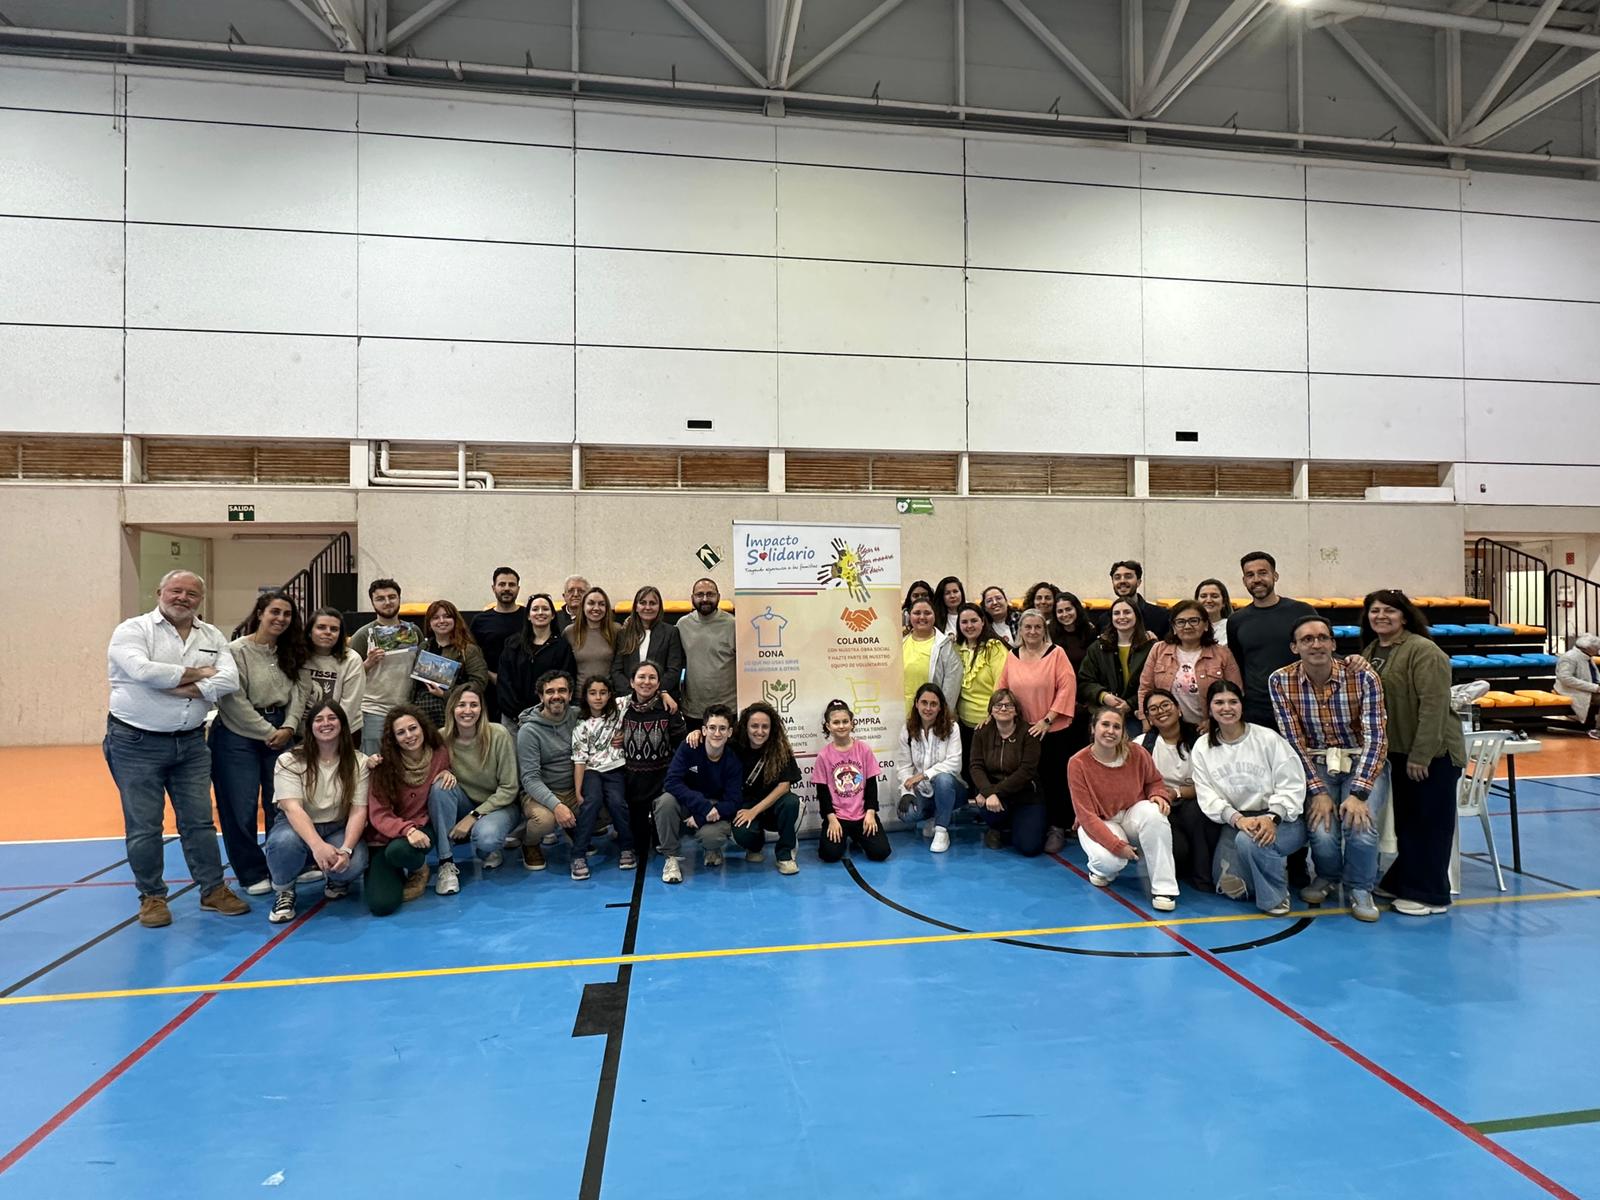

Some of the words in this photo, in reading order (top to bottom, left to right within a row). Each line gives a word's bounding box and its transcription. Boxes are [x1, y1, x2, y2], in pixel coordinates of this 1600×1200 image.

[745, 533, 799, 551] Impacto
[836, 637, 880, 645] COLABORA
[758, 650, 784, 658] DONA
[310, 669, 337, 679] TISSE
[853, 717, 881, 725] OMPRA
[878, 760, 895, 768] CRO
